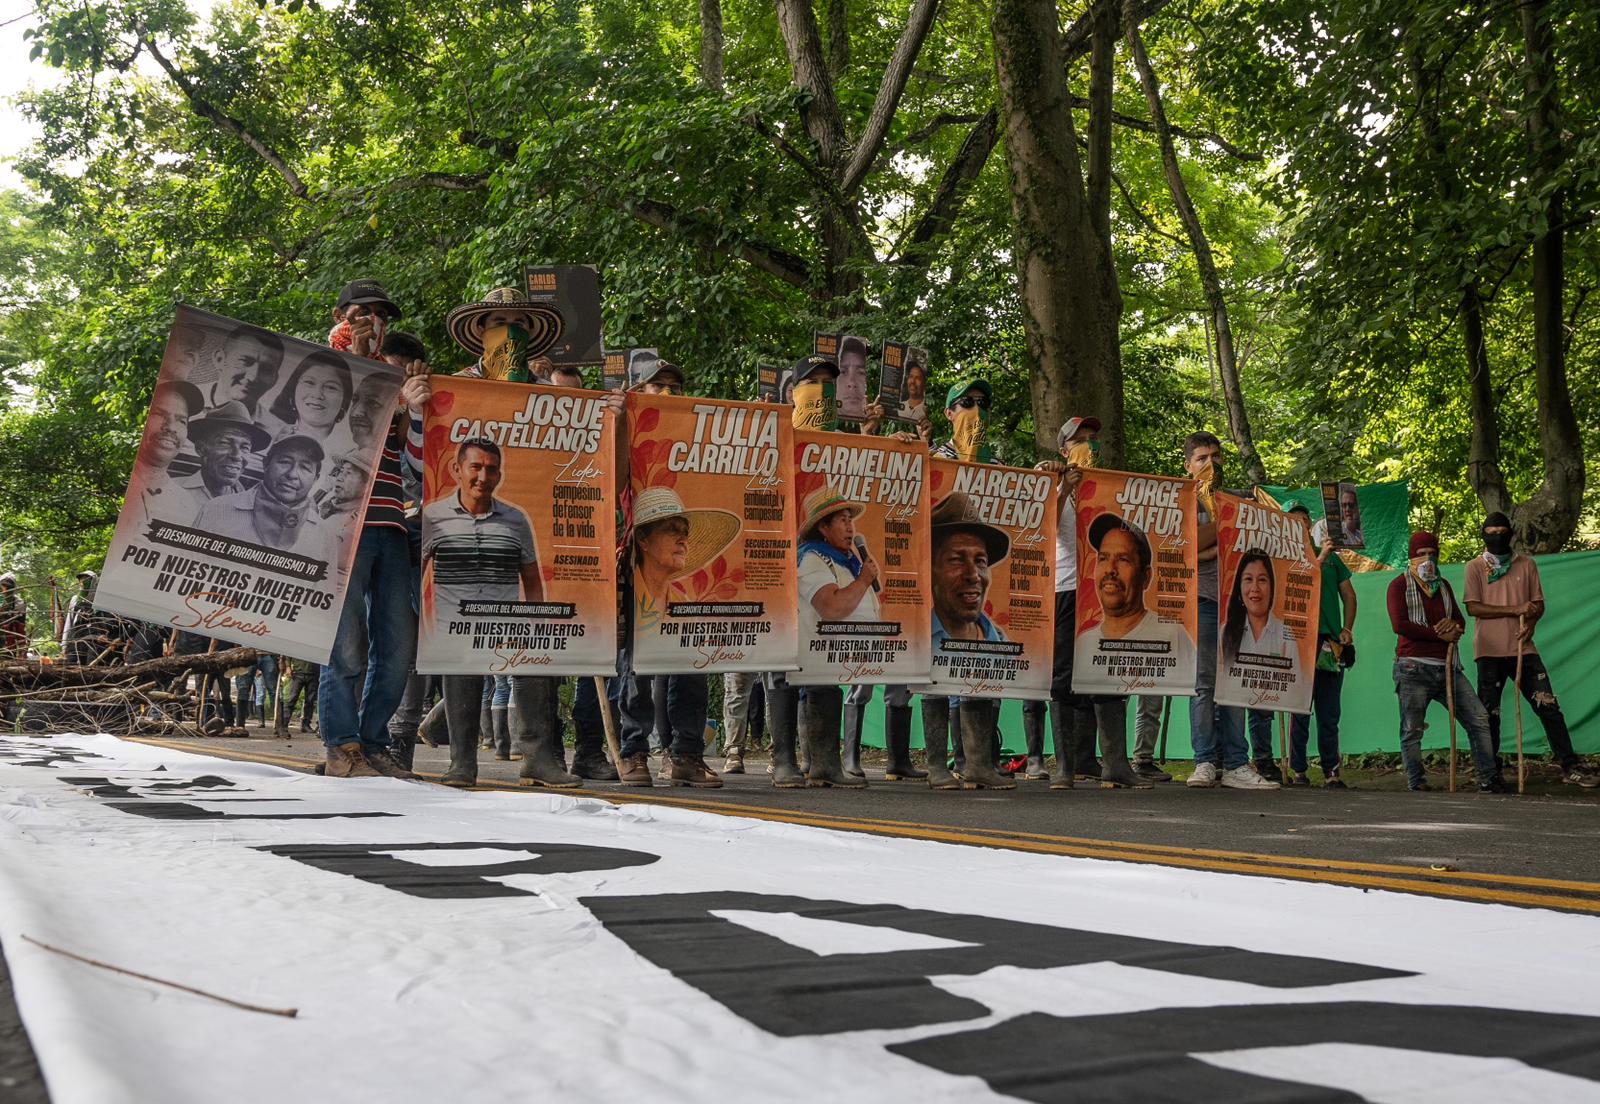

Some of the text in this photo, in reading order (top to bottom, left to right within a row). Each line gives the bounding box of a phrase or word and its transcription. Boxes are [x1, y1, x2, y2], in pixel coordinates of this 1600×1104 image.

[528, 273, 556, 285] CARLOS
[513, 393, 606, 431] JOSUE
[450, 418, 601, 454] CASTELLANOS
[692, 404, 779, 448] TULIA
[667, 440, 779, 477] CARRILLO
[800, 443, 924, 482] CARMELINA
[553, 484, 604, 504] campesino,
[825, 472, 922, 506] YULE PAVI
[952, 466, 1051, 501] NARCISO
[1115, 477, 1184, 509] JORGE
[553, 499, 595, 519] defensor
[553, 518, 595, 539] de la vida
[1121, 504, 1183, 536] TAFUR
[1235, 502, 1303, 544] EDILSAN
[156, 527, 320, 576] #DESMONTE DEL PARAMILITARISMO YA
[744, 539, 791, 549] SECUESTRADA
[749, 549, 786, 559] ASESINADA
[1232, 528, 1306, 562] ANDRADE
[553, 554, 600, 566] ASESINADO
[121, 544, 335, 611] POR NUESTROS MUERTOS
[153, 572, 303, 623] NI UN MINUTO DE
[170, 591, 272, 637] Silencio
[448, 622, 585, 637] POR NUESTROS MUERTOS
[660, 621, 772, 635] POR NUESTRAS MUERTAS
[472, 636, 567, 650] NI UN MINUTO DE
[680, 634, 757, 648] NI UN MINUTO DE
[809, 639, 908, 652] POR NUESTRAS MUERTAS
[489, 640, 553, 672] Silencio
[693, 640, 746, 669] Silencio
[827, 651, 895, 663] NI UN MINUTO DE
[932, 655, 1030, 670] POR NUESTROS MUERTOS
[1092, 655, 1177, 667] POR NUESTROS MUERTOS
[838, 656, 886, 682] Silencio
[949, 667, 1017, 680] NI UN MINUTO DE
[1107, 666, 1166, 677] NI UN MINUTO DE
[1229, 667, 1296, 683] POR NUESTRAS MUERTAS
[1241, 679, 1249, 688] NI
[1258, 680, 1280, 691] MINUTO
[1280, 682, 1288, 692] DE
